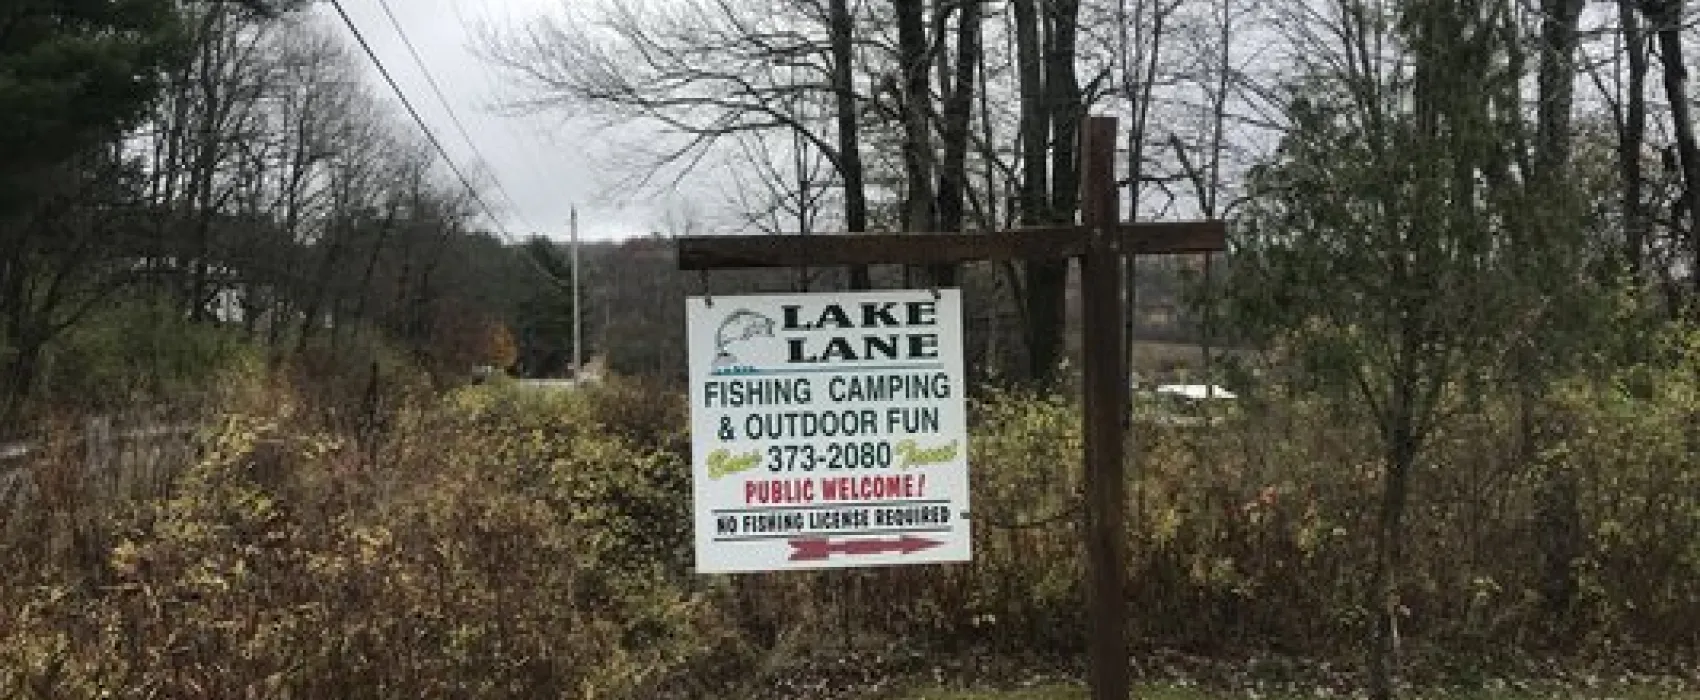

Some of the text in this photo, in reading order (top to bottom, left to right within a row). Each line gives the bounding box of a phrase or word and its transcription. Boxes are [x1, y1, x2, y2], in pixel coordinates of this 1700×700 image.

[781, 303, 935, 331] LAKE
[788, 334, 938, 363] LANE
[704, 373, 950, 408] FISHING CAMPING
[718, 407, 939, 441] & OUTDOOR FUN
[768, 442, 891, 472] 373-2080
[745, 473, 926, 504] PUBLIC WELCOME!
[717, 505, 949, 533] NO FISHING LICENSE REQUIRED
